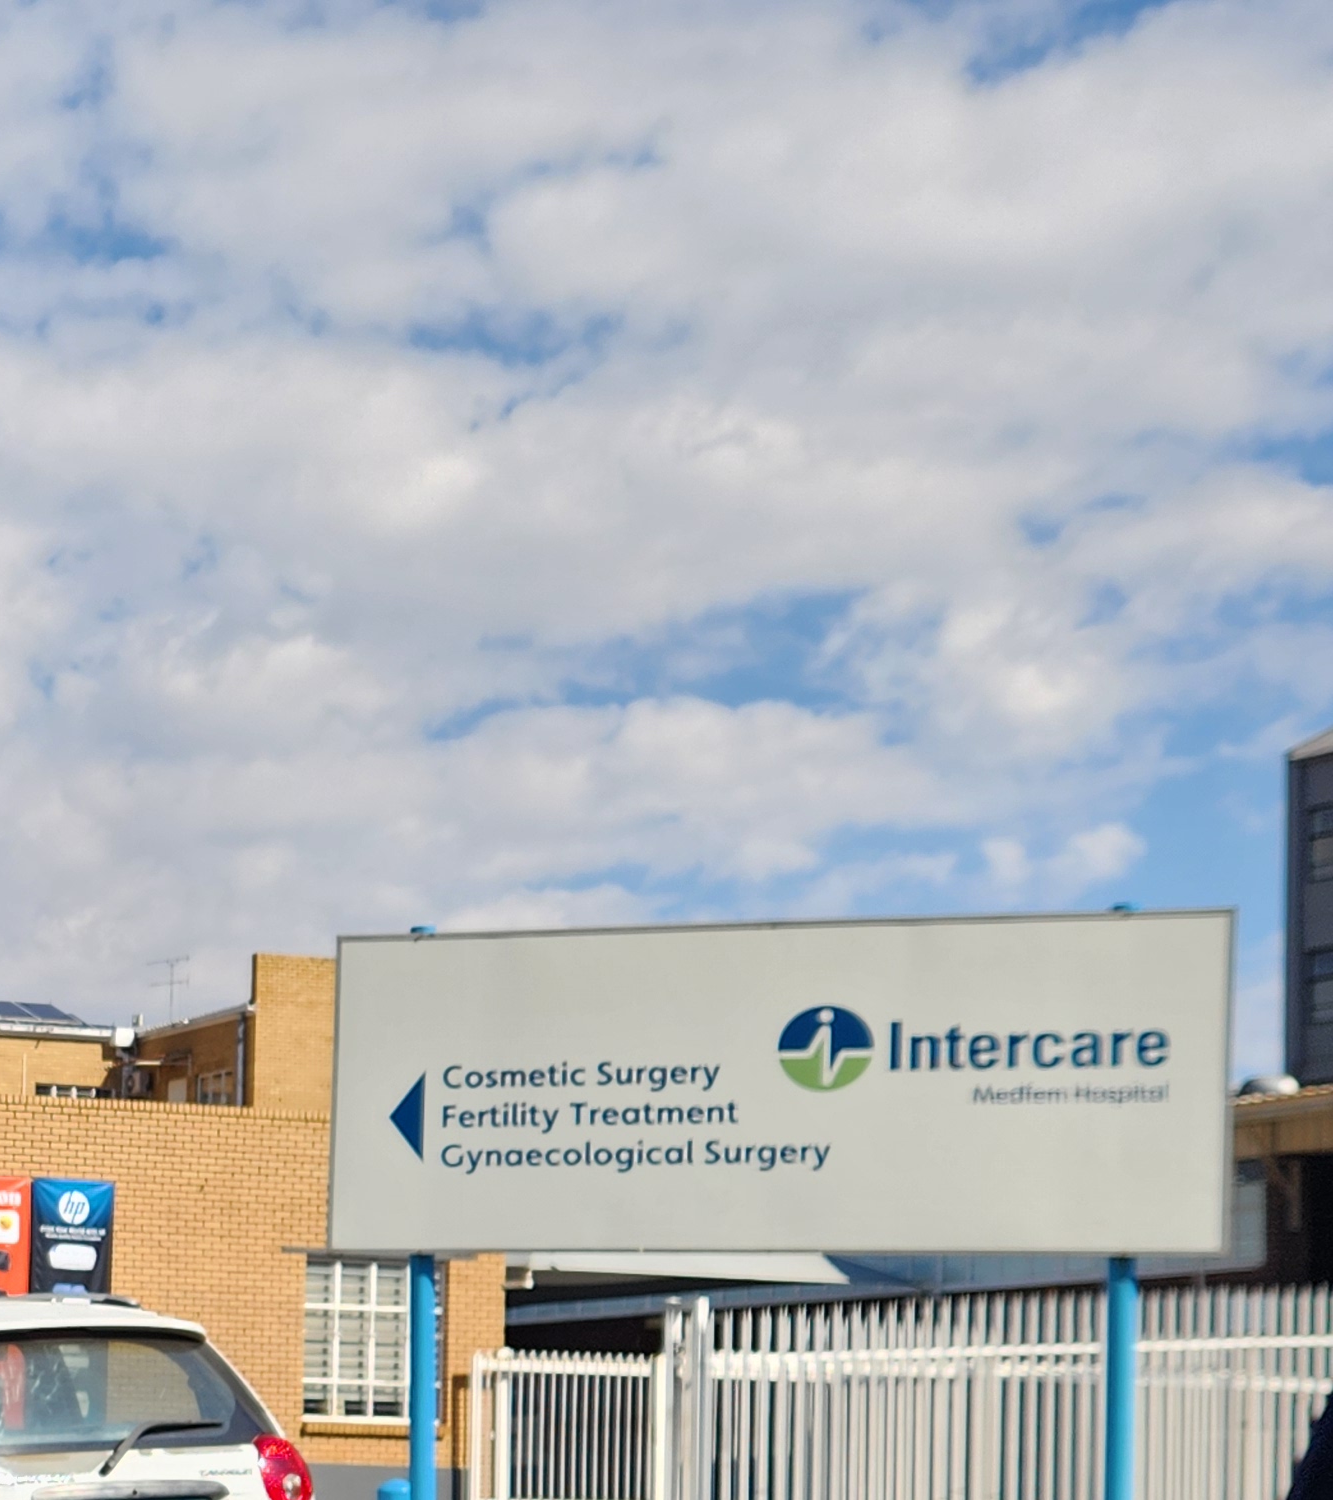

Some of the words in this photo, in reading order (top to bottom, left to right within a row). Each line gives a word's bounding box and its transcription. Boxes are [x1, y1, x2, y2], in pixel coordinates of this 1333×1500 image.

[889, 1021, 1170, 1071] Intercare
[442, 1060, 586, 1089] Cosmetic
[596, 1061, 721, 1092] Surgery
[972, 1082, 1068, 1105] Medfem
[1075, 1081, 1170, 1107] Hospital
[442, 1101, 559, 1134] Fertility
[570, 1100, 739, 1127] Treatment
[441, 1138, 694, 1175] Gynaecological
[704, 1140, 831, 1171] Surgery
[63, 1190, 86, 1225] hp
